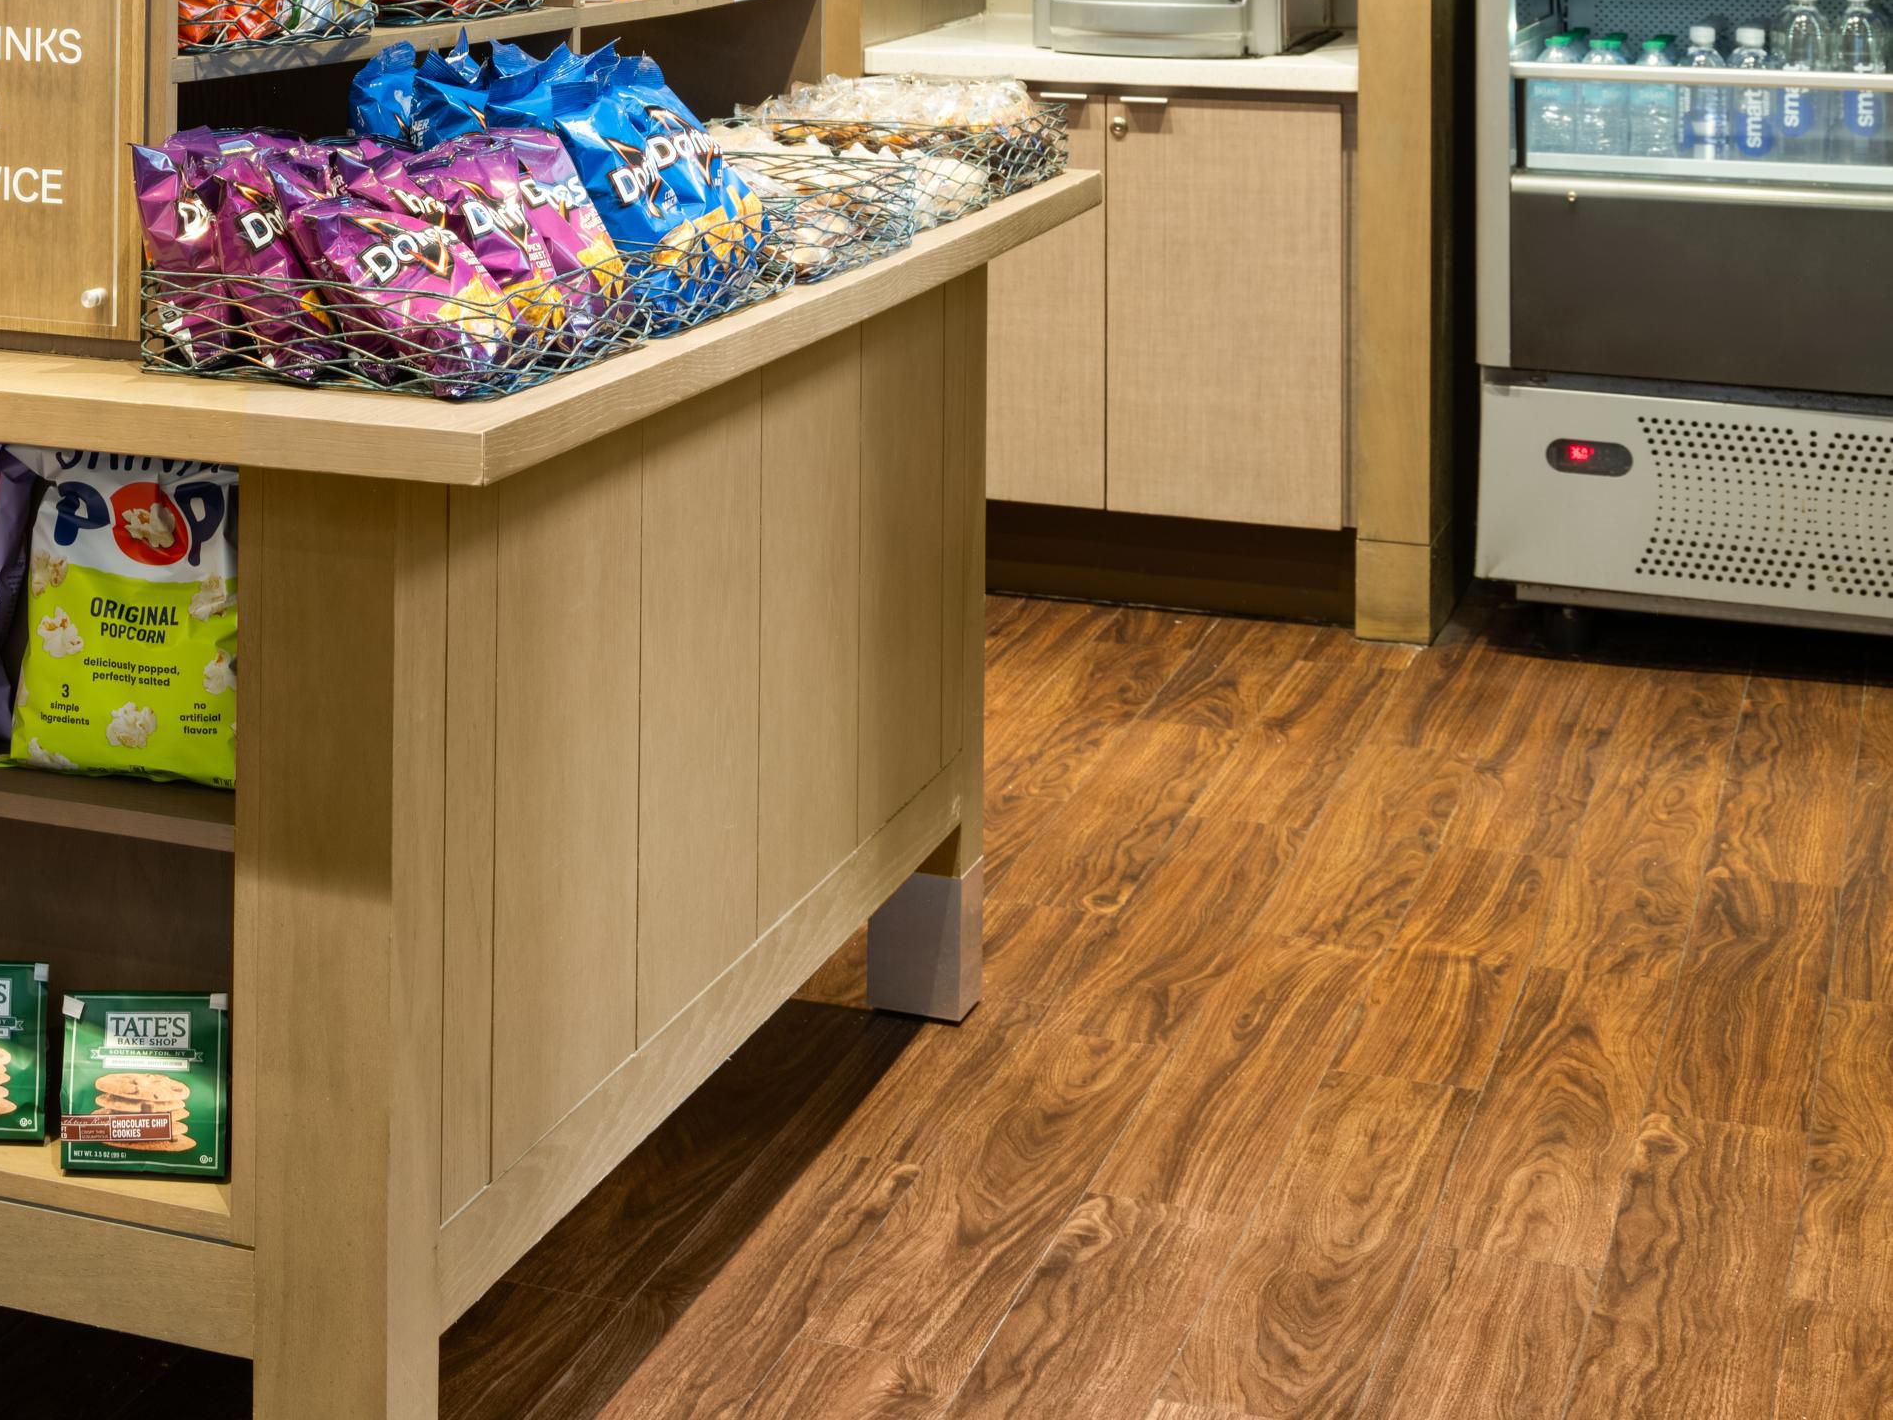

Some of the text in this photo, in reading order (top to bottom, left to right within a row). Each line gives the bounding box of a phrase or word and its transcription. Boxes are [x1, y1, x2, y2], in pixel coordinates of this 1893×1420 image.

[1744, 88, 1763, 148] smart
[90, 597, 179, 627] ORIGINAL
[100, 622, 166, 644] POPCORN
[83, 657, 180, 676] deliciously popped,
[92, 670, 170, 687] perfectly salted
[61, 683, 70, 698] 3
[50, 701, 79, 713] simple
[193, 702, 207, 710] no
[40, 712, 90, 726] ingredients
[179, 714, 221, 723] artificial
[183, 726, 218, 735] flavors
[110, 1017, 186, 1038] TATE'S
[117, 1038, 177, 1046] BAKE SHOP
[112, 1118, 168, 1129] CHOCOLATE CHIP
[112, 1129, 141, 1138] COOKIES
